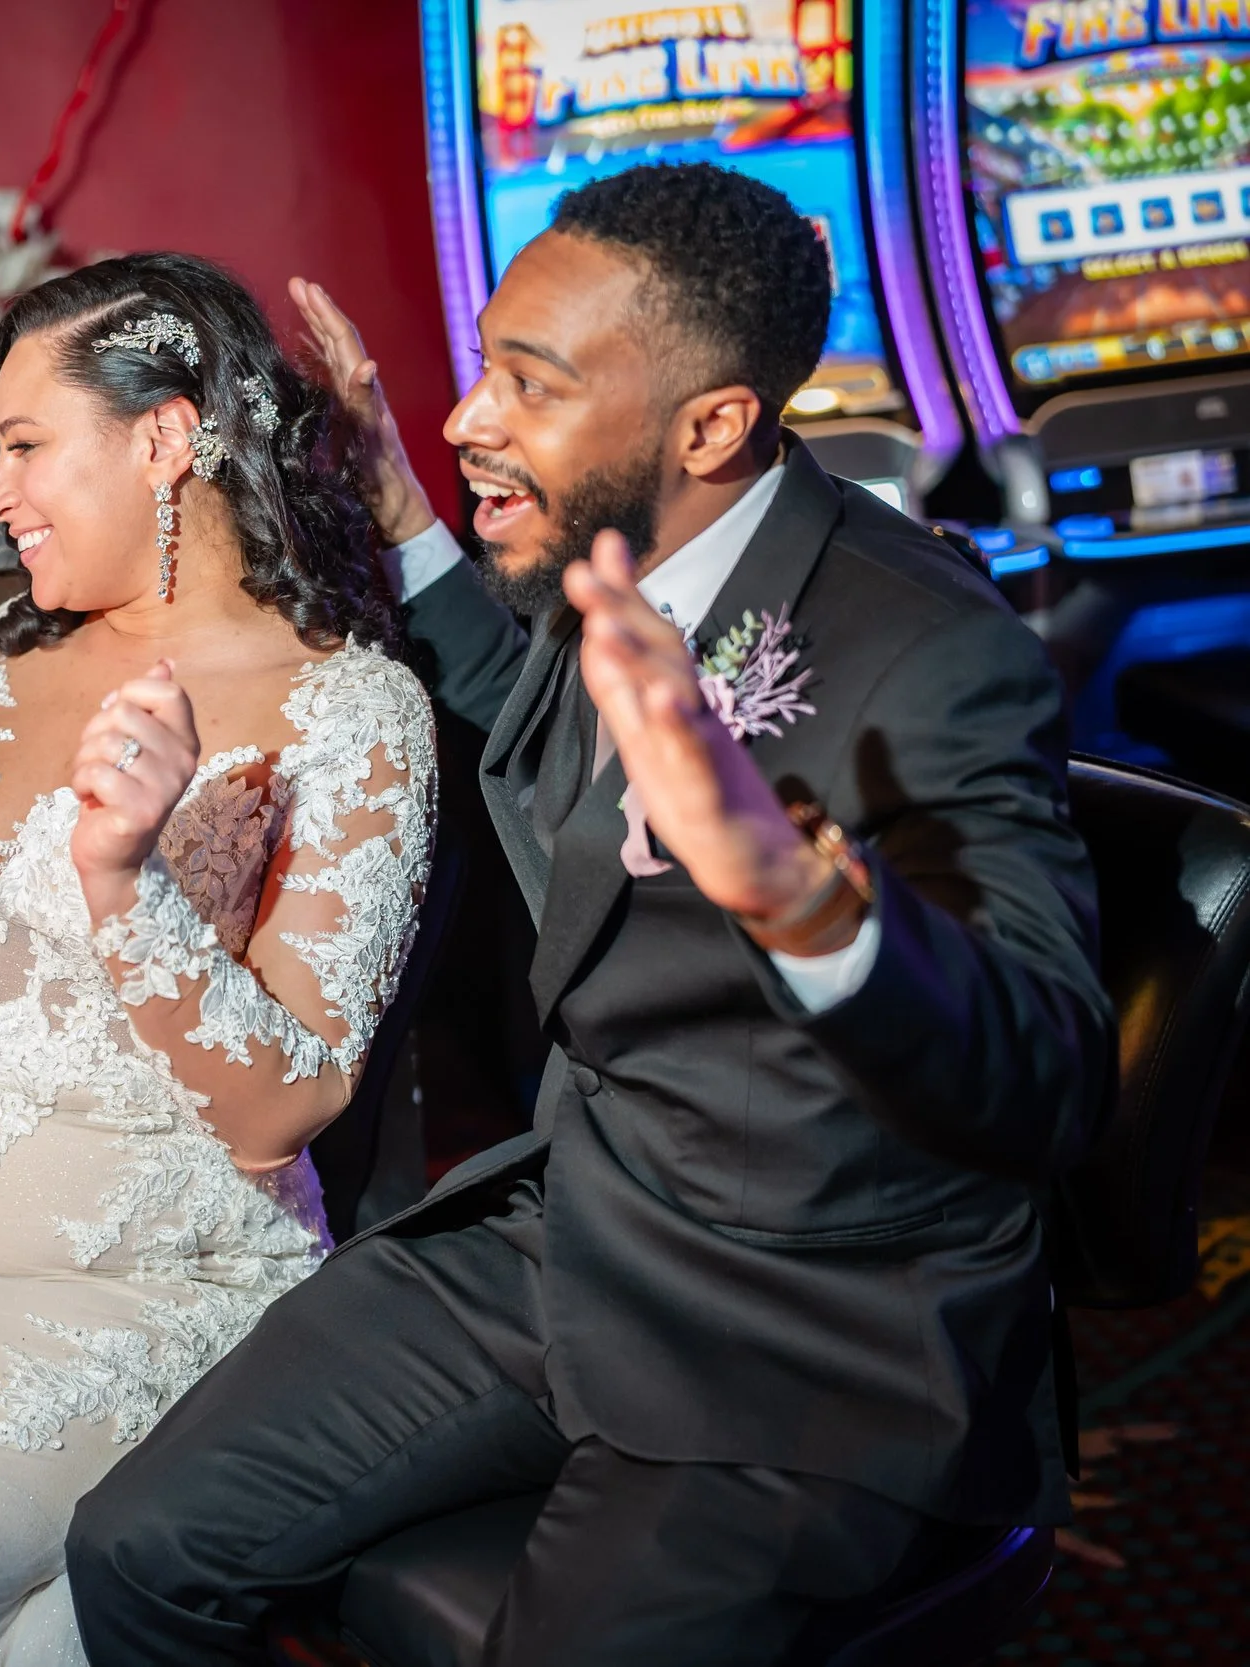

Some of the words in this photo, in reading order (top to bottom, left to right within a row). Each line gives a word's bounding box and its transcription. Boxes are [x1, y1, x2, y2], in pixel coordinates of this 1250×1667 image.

[1020, 0, 1148, 61] FIRE
[537, 45, 669, 123] FIRE
[675, 40, 801, 92] LINK
